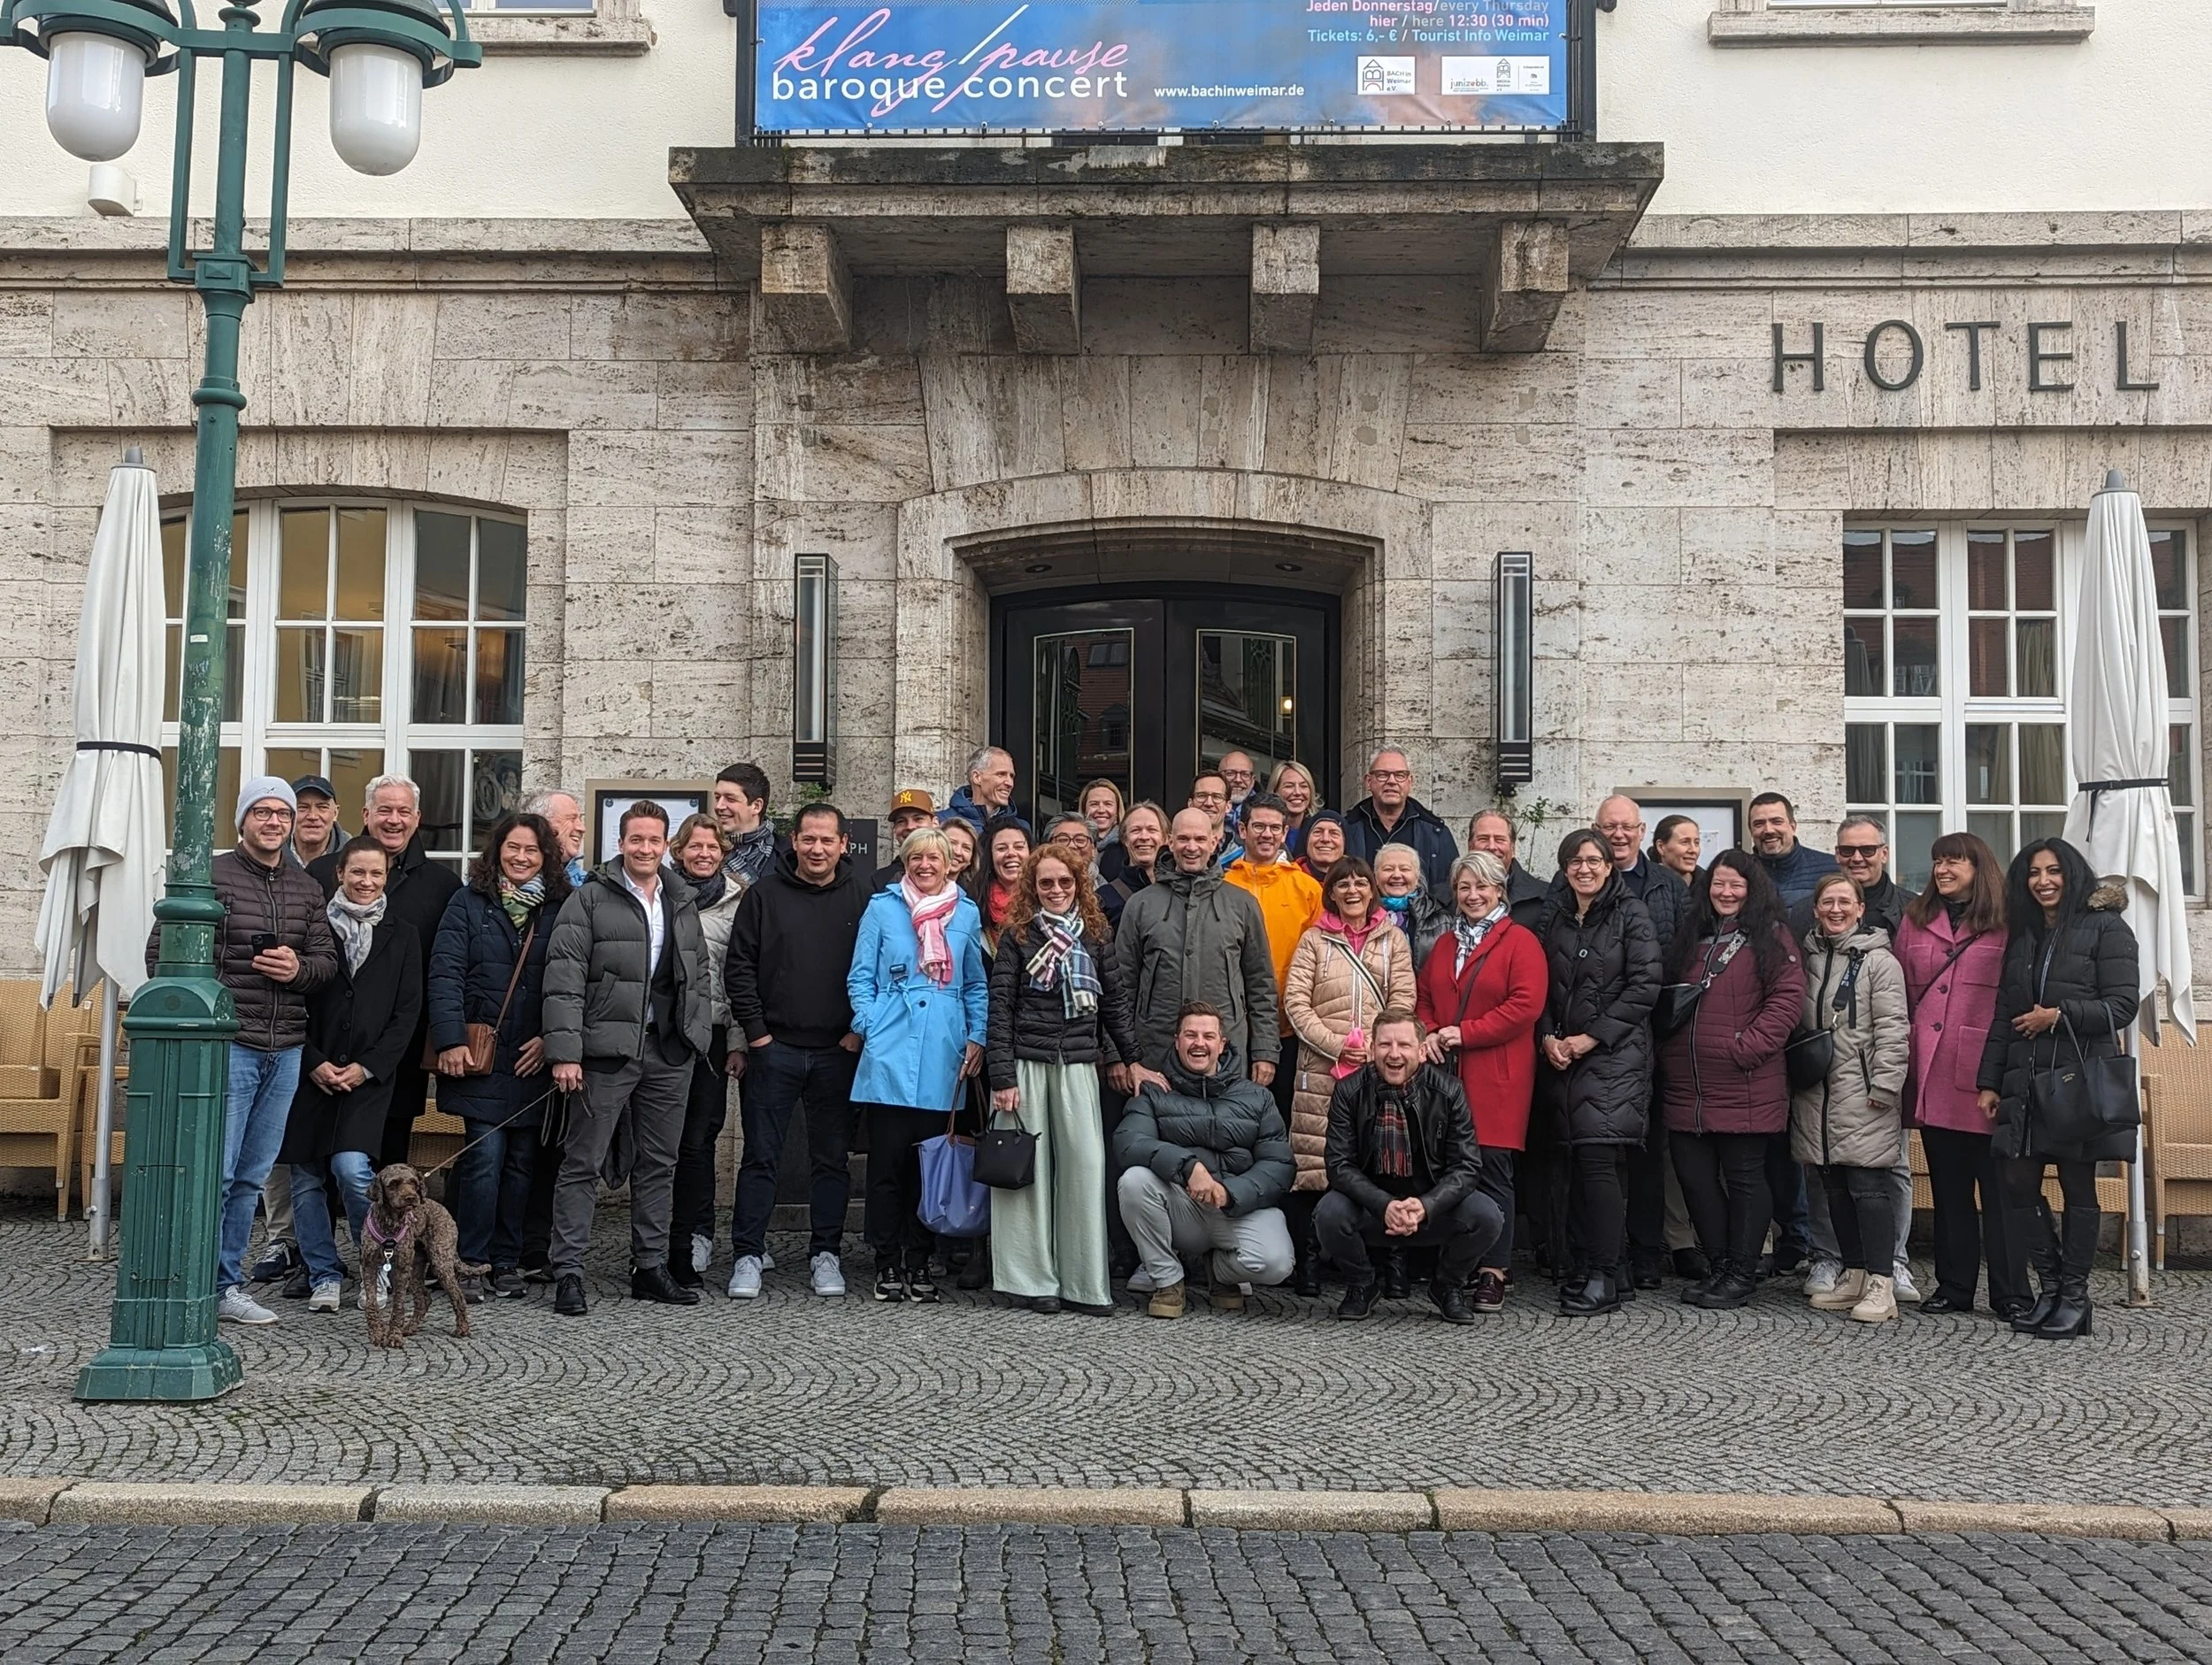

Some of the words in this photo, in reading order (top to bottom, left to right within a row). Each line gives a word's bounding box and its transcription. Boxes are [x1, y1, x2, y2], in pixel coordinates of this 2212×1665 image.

[1306, 0, 1348, 12] Jeden
[1483, 0, 1548, 12] Thursday
[1370, 15, 1398, 27] hier
[1412, 15, 1444, 27] here
[1449, 14, 1486, 27] 12:30
[1492, 13, 1513, 27] (30
[1518, 13, 1548, 27] min)
[1308, 29, 1363, 42] Tickets:
[1366, 29, 1385, 42] 6,-
[1388, 29, 1398, 42] €
[1411, 29, 1461, 42] Tourist
[1465, 29, 1491, 42] Info
[1494, 29, 1549, 42] Weimar
[772, 72, 946, 106] baroque
[963, 71, 1128, 99] concert
[1154, 84, 1304, 97] www.bachinweimar.de
[1772, 318, 2160, 392] HOTEL
